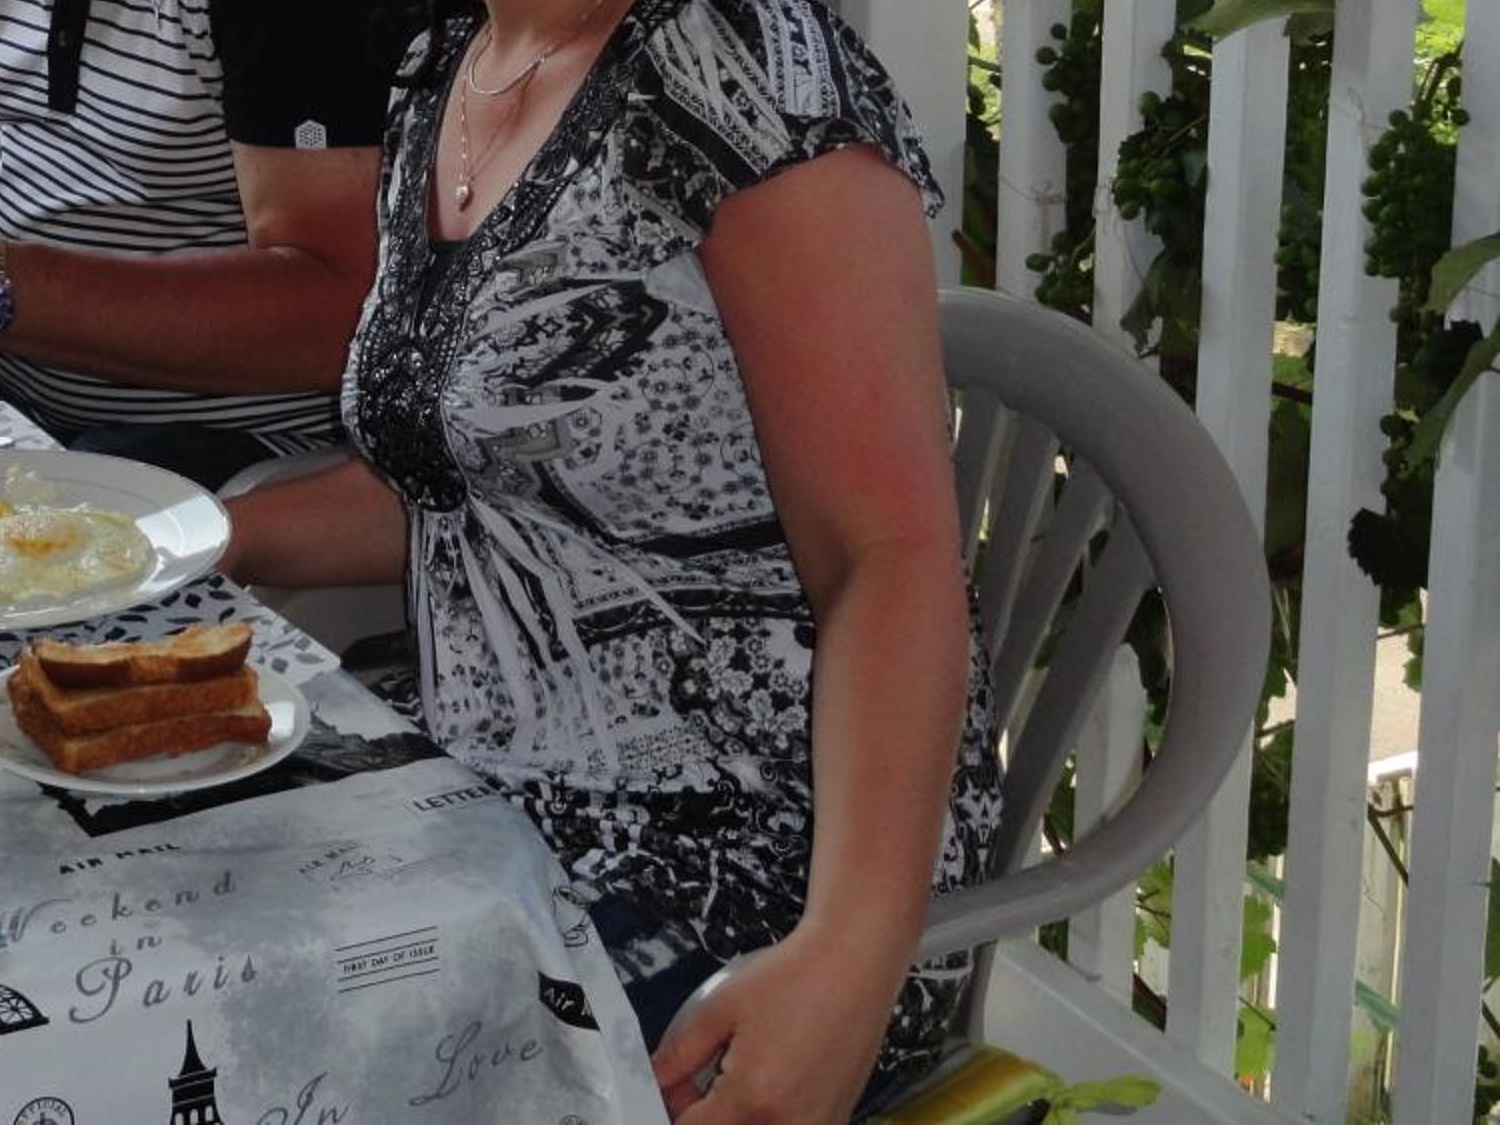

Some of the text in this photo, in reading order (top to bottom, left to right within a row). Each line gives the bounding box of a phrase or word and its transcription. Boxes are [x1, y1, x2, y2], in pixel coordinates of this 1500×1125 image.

[59, 843, 181, 875] AIR MAIL
[342, 944, 435, 973] FIRST DAY OF ISSUE
[408, 1021, 544, 1107] Love
